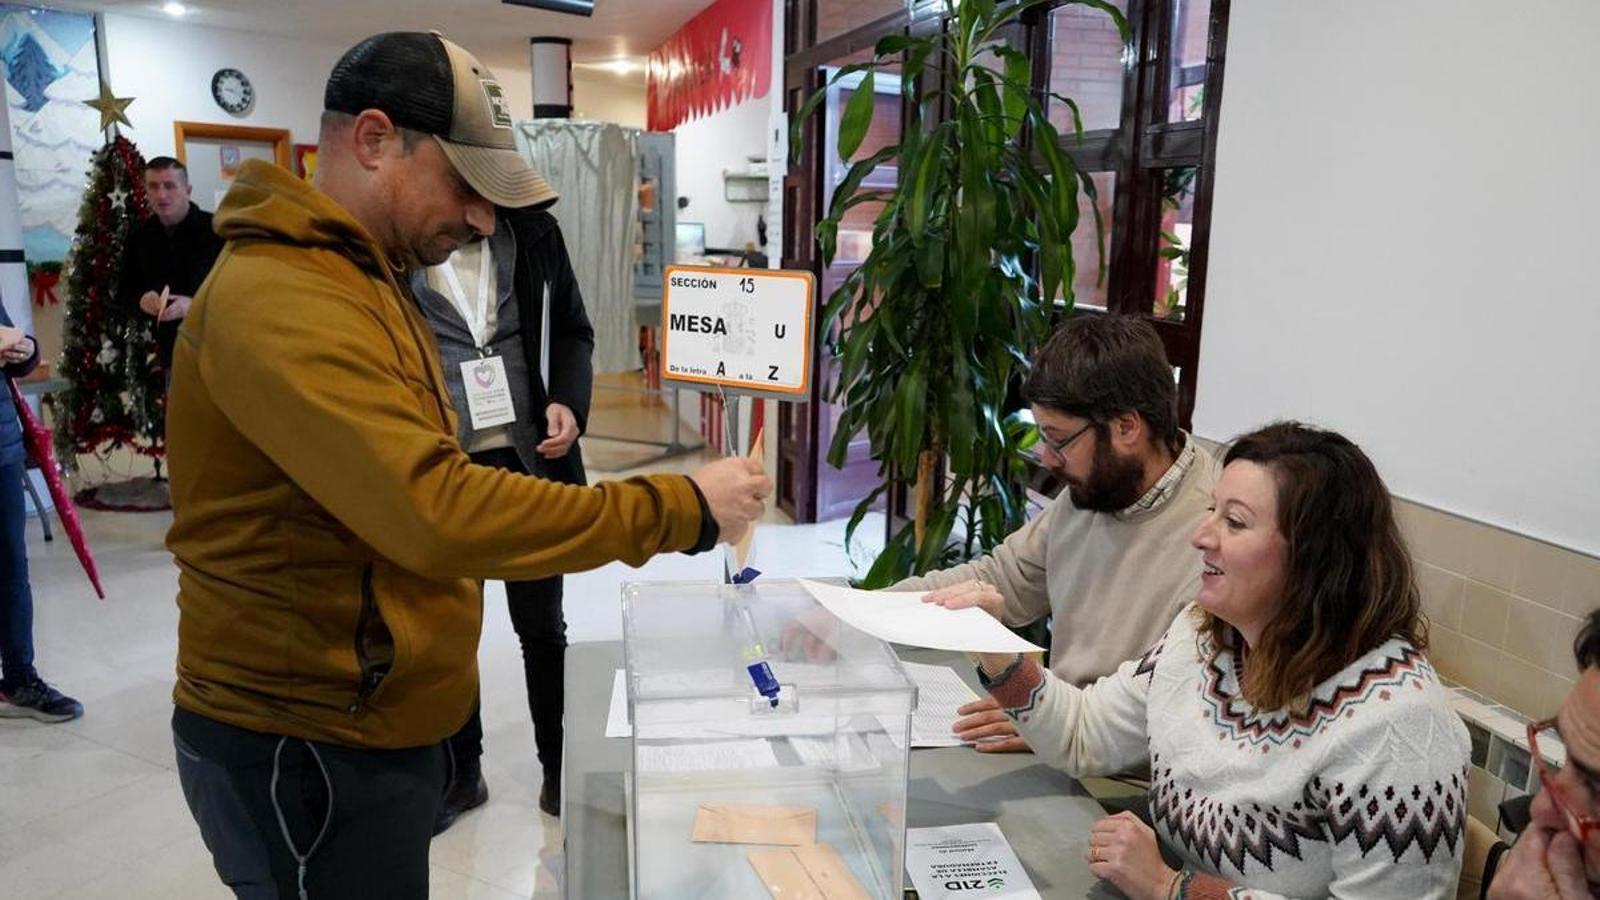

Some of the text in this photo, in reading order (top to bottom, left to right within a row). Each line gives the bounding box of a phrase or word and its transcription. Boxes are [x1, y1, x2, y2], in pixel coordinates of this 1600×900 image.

[671, 277, 755, 293] SECCIÓN 15
[670, 314, 786, 339] MESA U
[670, 364, 680, 372] De
[689, 366, 707, 375] letra
[716, 361, 726, 376] A
[745, 372, 753, 380] la
[768, 365, 779, 381] Z
[930, 861, 998, 869] EXTREMADURA
[953, 870, 1008, 878] ELECCIONES
[944, 880, 985, 891] 21D
